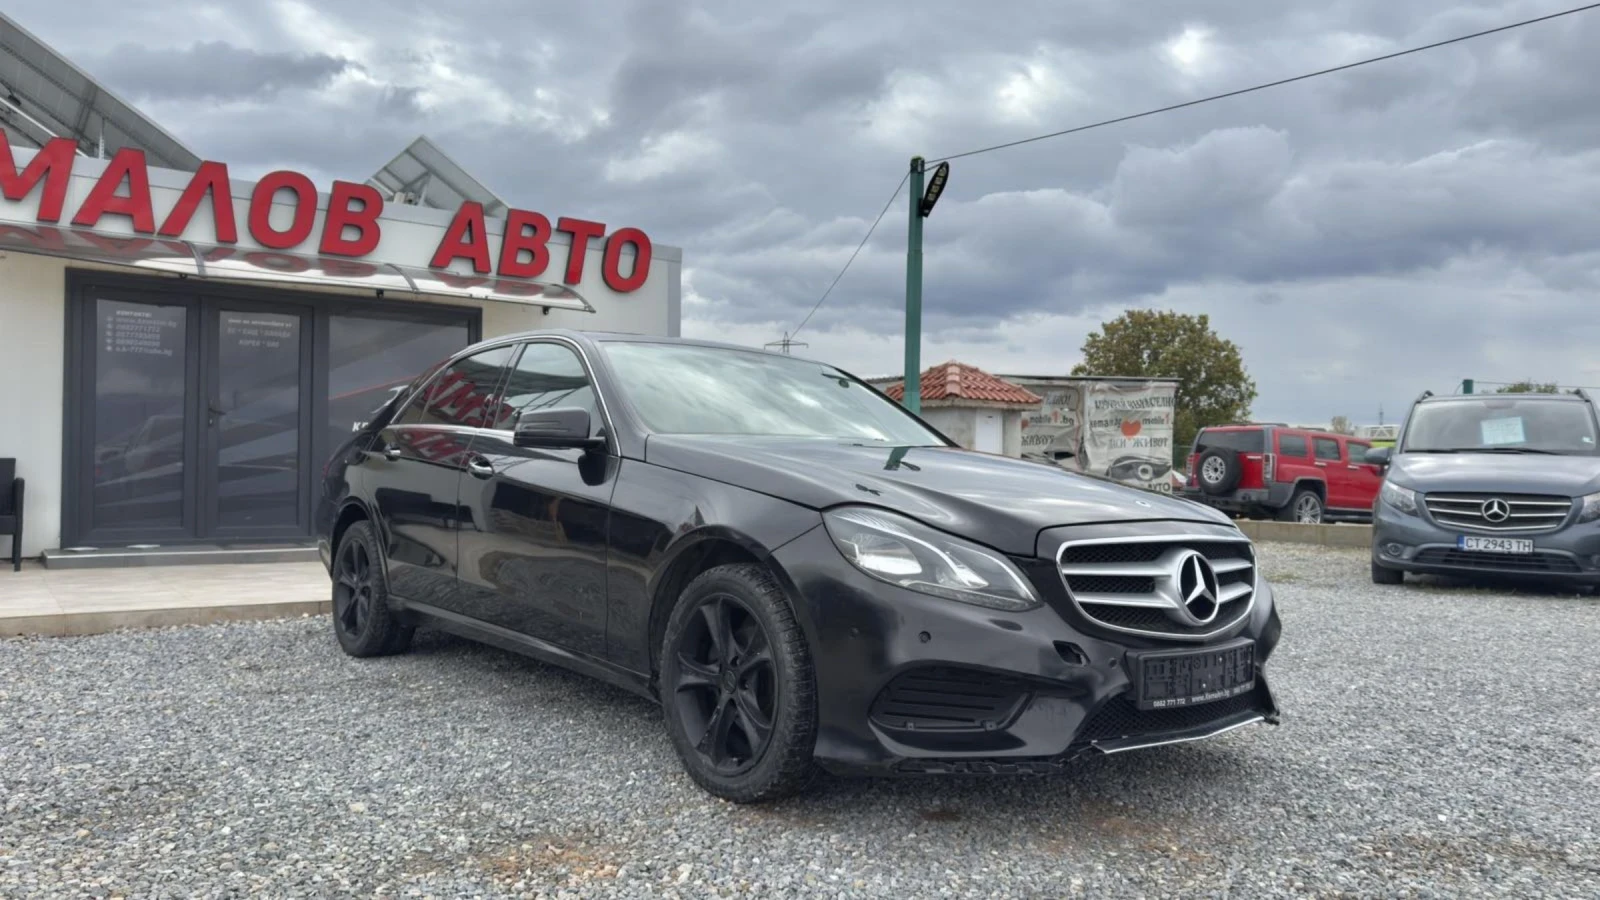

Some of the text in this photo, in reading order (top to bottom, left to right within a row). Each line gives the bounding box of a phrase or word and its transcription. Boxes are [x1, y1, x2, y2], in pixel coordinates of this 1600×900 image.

[0, 128, 652, 293] МАЛОВ АВТО
[1483, 539, 1513, 550] 2943
[1516, 540, 1531, 551] TH
